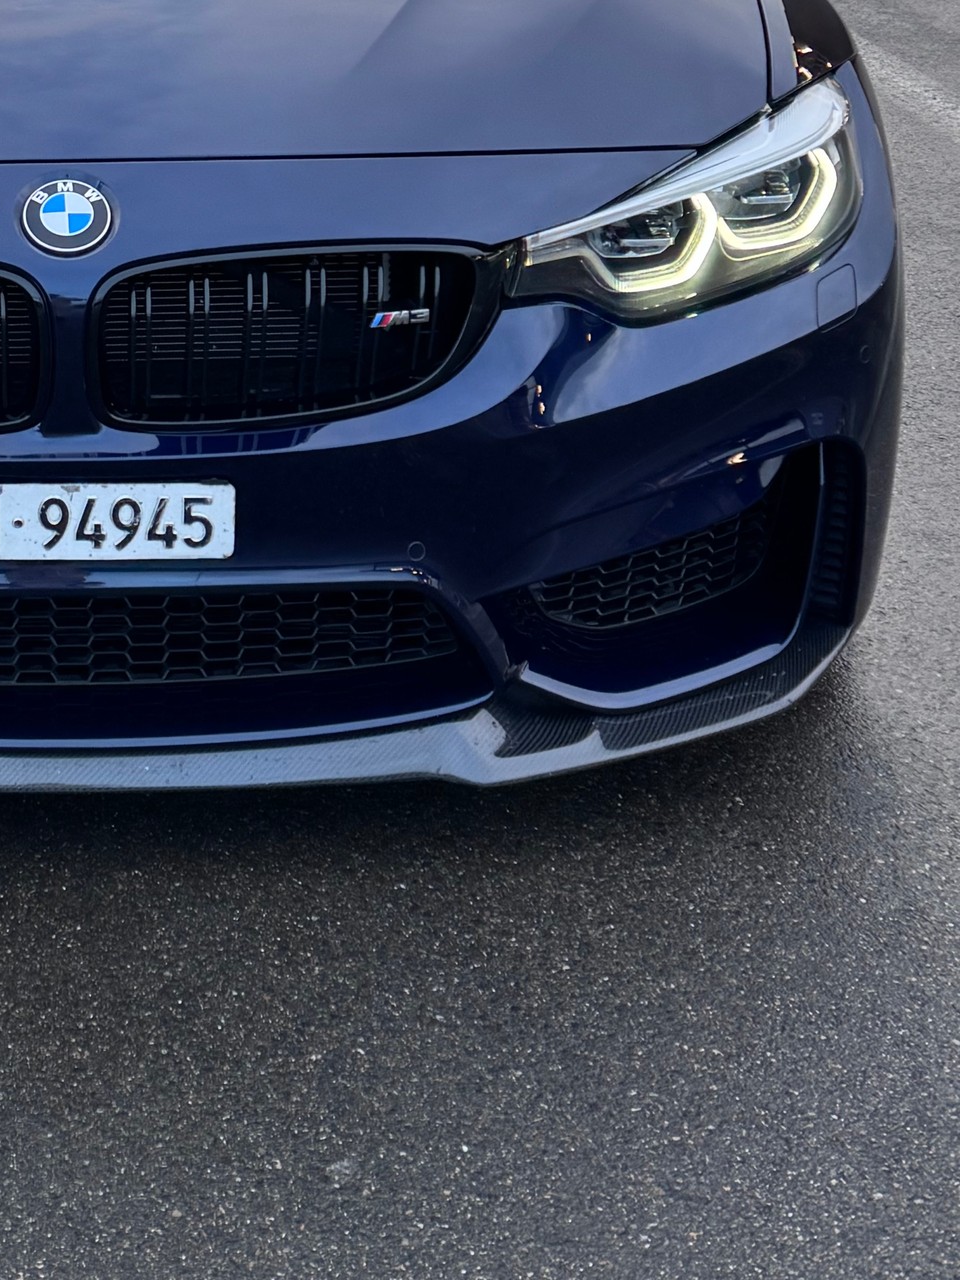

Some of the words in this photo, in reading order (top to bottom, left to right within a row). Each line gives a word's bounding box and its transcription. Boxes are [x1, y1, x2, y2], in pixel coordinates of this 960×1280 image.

[32, 182, 102, 204] BMW
[384, 308, 430, 330] M3
[40, 497, 213, 550] 94945
